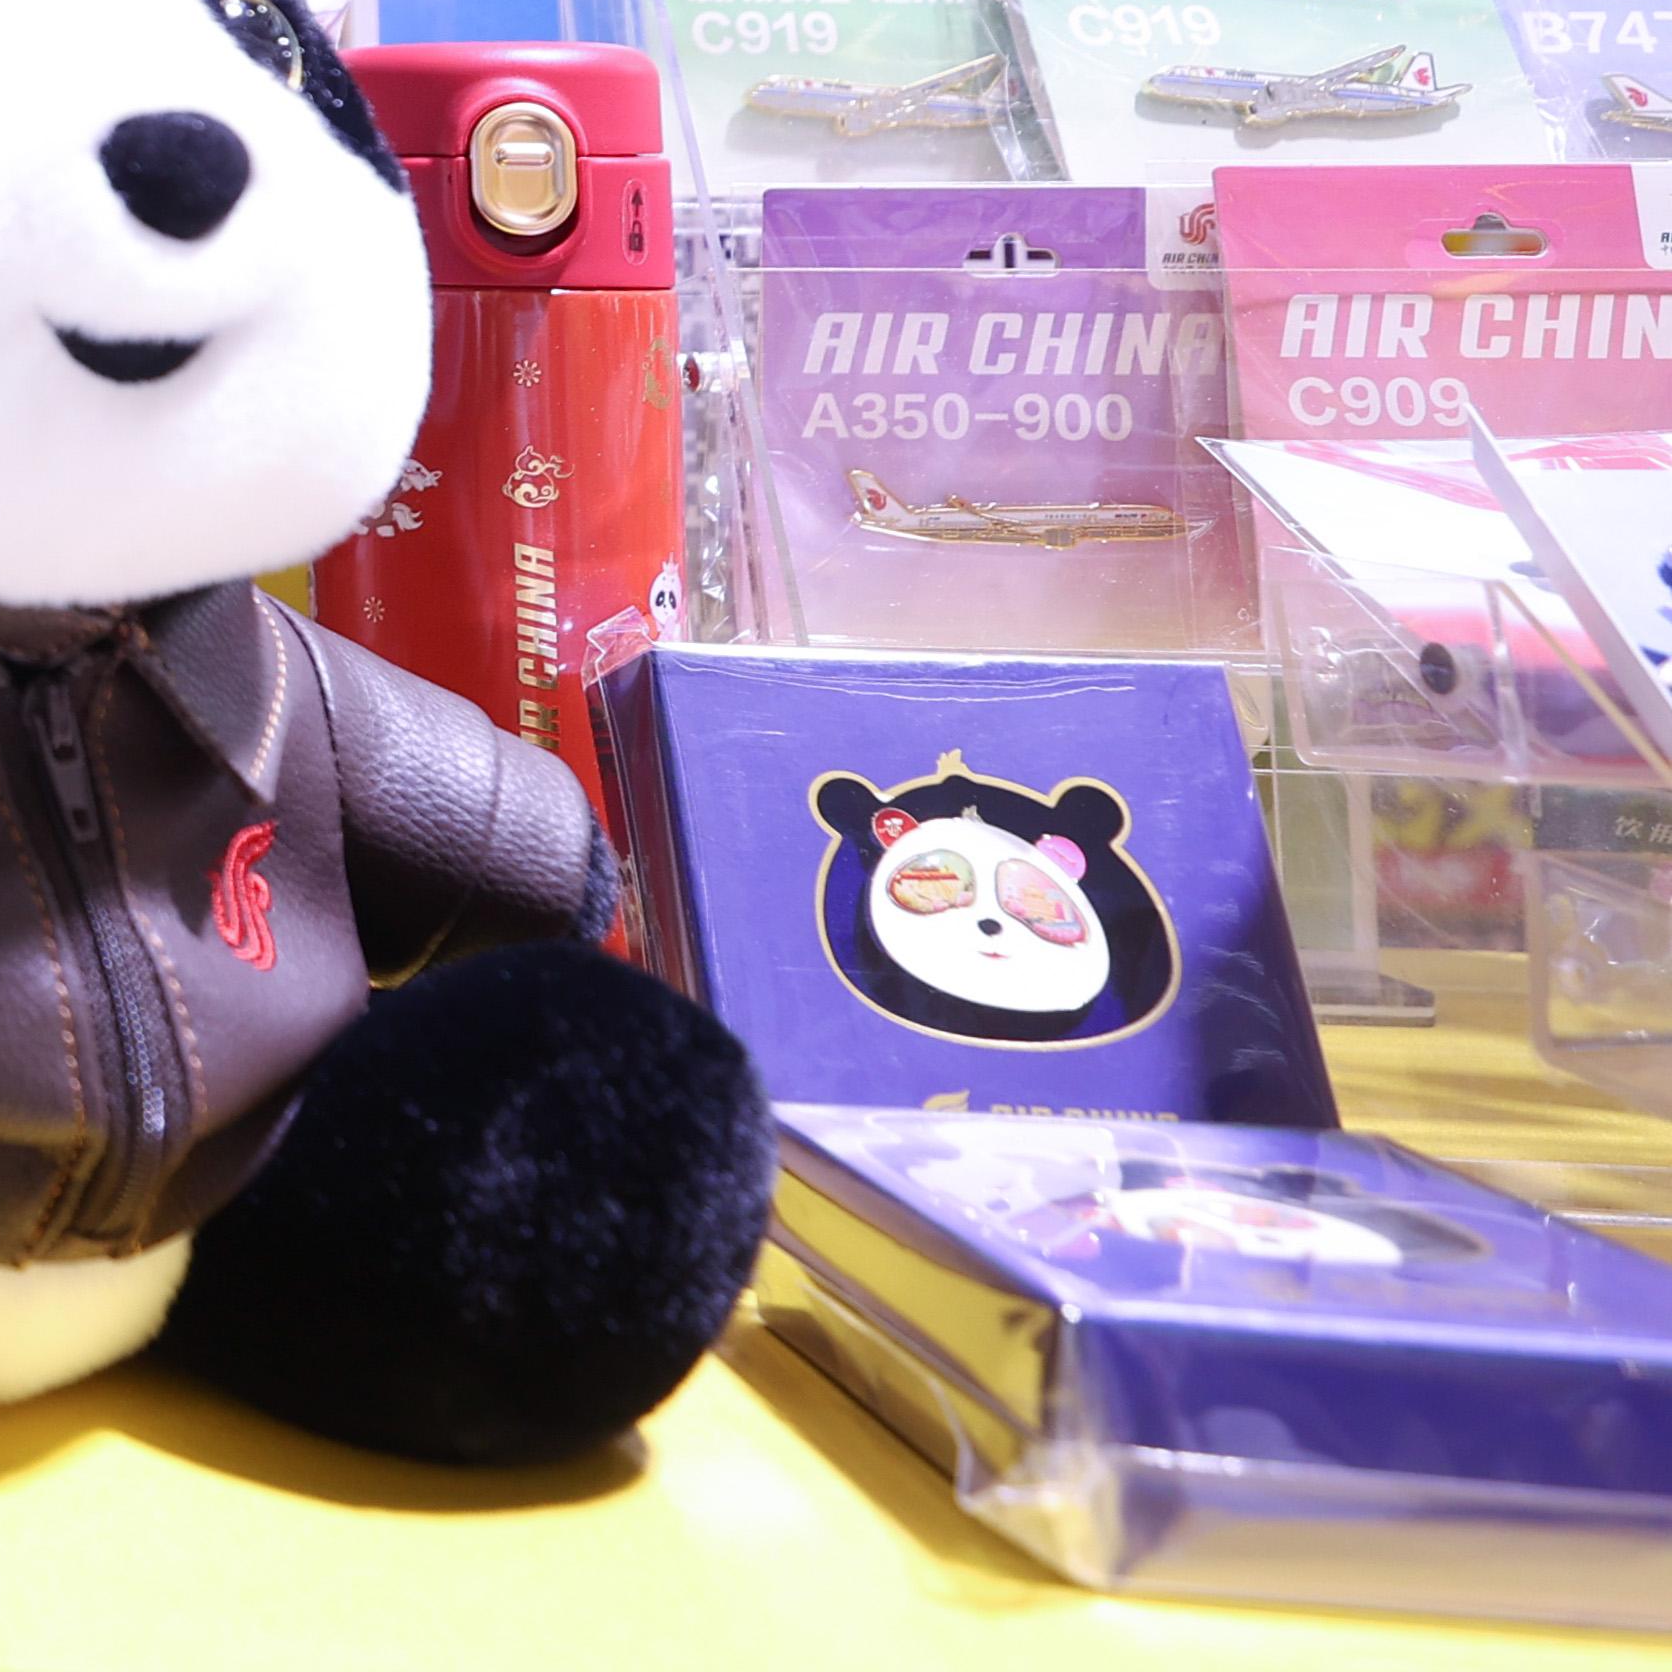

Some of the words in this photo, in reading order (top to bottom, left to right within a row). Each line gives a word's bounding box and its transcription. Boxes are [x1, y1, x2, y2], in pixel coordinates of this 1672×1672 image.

[692, 12, 838, 54] C919
[1067, 4, 1222, 48] C919
[1162, 252, 1185, 264] AIR
[802, 312, 950, 375] AIR
[968, 312, 1223, 376] CHINA
[1280, 293, 1434, 359] AIR
[801, 392, 1134, 441] A350-900
[1288, 376, 1471, 428] C909
[513, 542, 559, 692] CHINA
